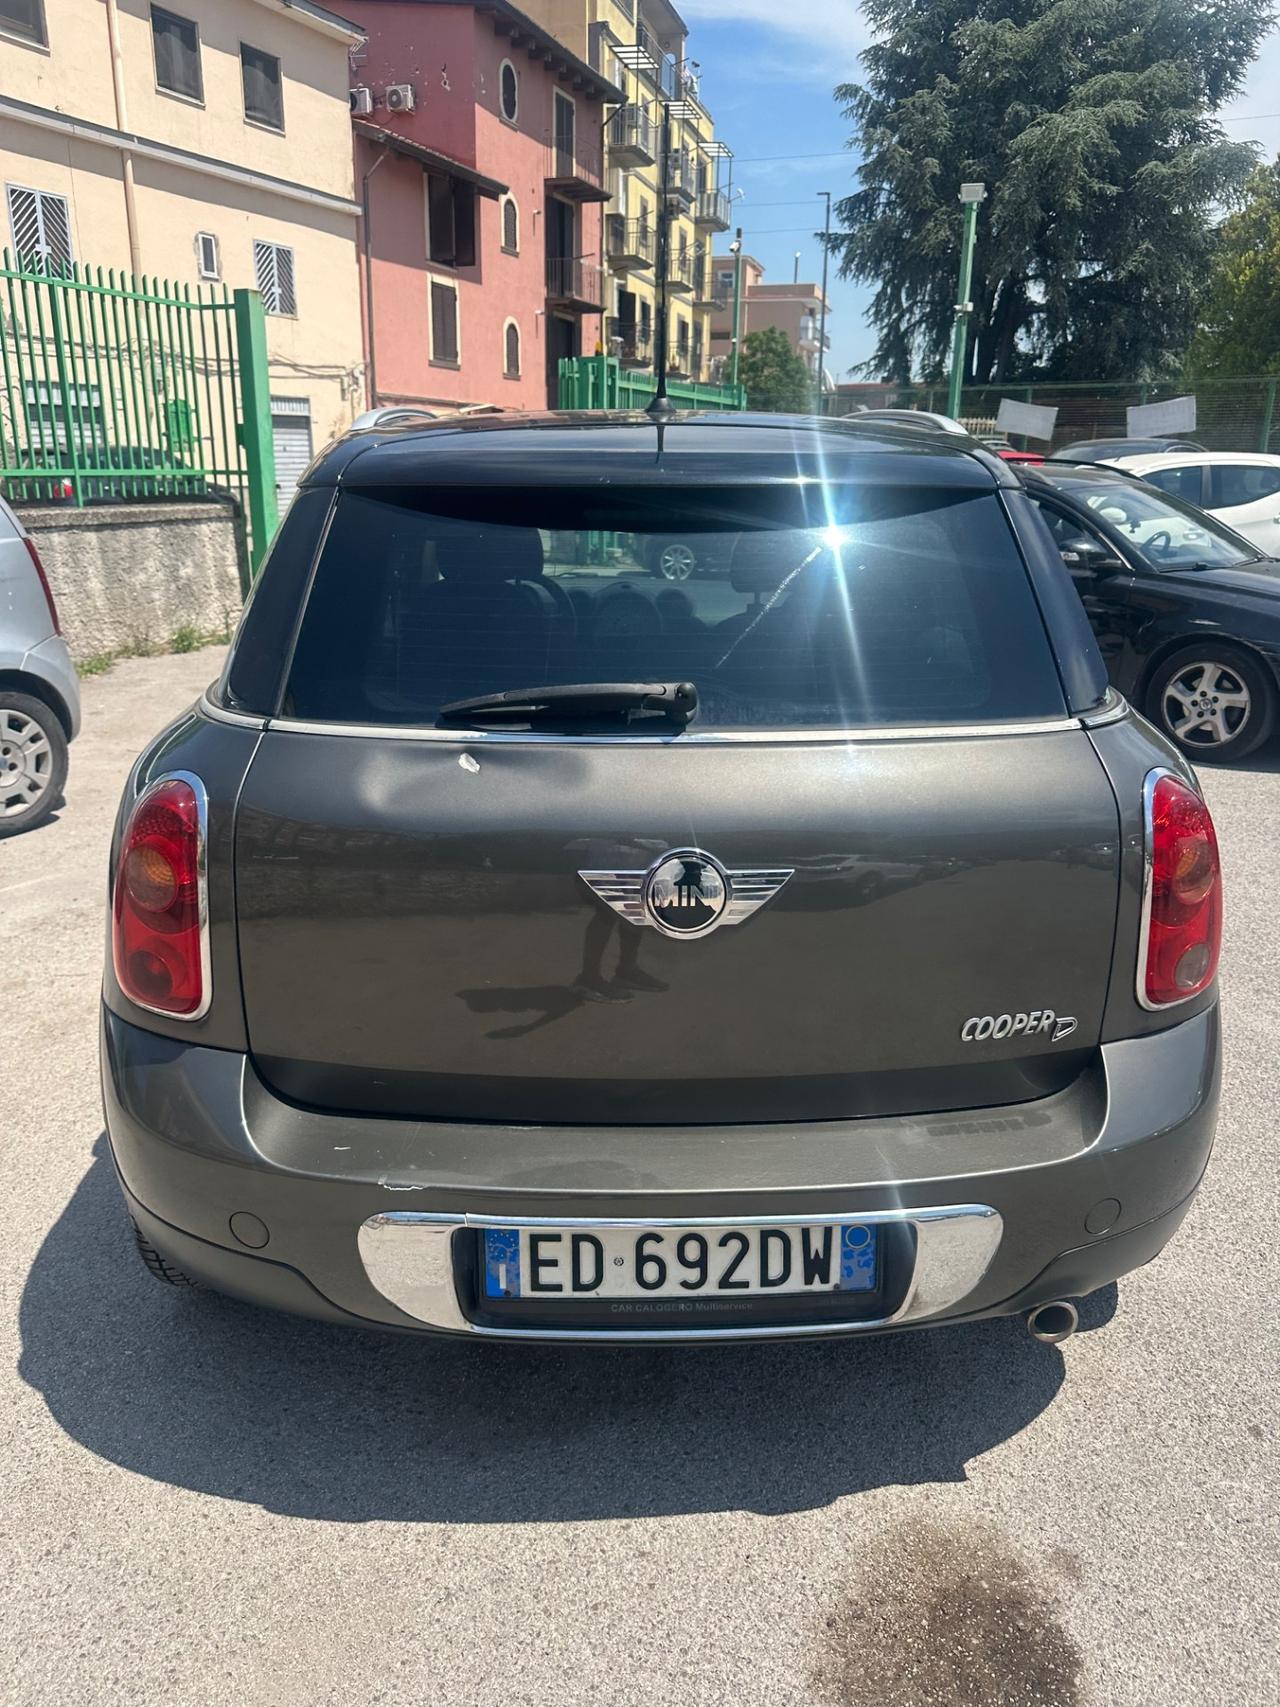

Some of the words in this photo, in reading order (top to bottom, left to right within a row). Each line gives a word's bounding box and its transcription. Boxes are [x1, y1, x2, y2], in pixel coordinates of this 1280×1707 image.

[961, 1009, 1055, 1041] COOPER
[1051, 1016, 1078, 1042] D
[529, 1233, 604, 1292] ED
[634, 1226, 833, 1291] 692DW
[611, 1303, 633, 1313] CAR
